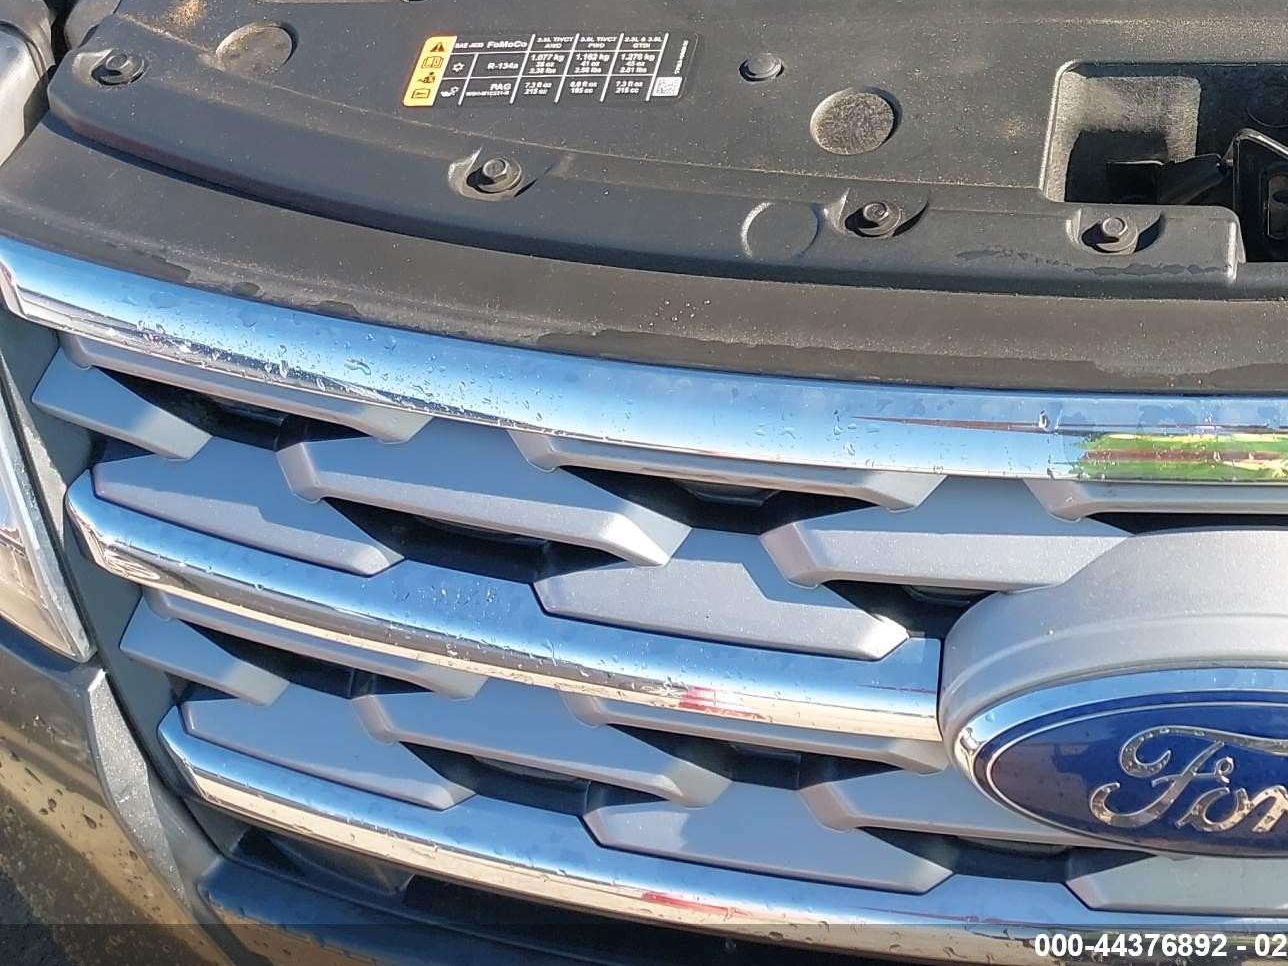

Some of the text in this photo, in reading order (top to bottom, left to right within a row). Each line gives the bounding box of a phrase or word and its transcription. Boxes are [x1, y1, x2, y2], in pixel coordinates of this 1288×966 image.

[487, 40, 528, 48] FoMoCo
[553, 54, 565, 62] kg
[598, 53, 610, 62] kg
[644, 53, 656, 62] kg
[487, 62, 519, 70] R-134a
[490, 83, 512, 91] PAG
